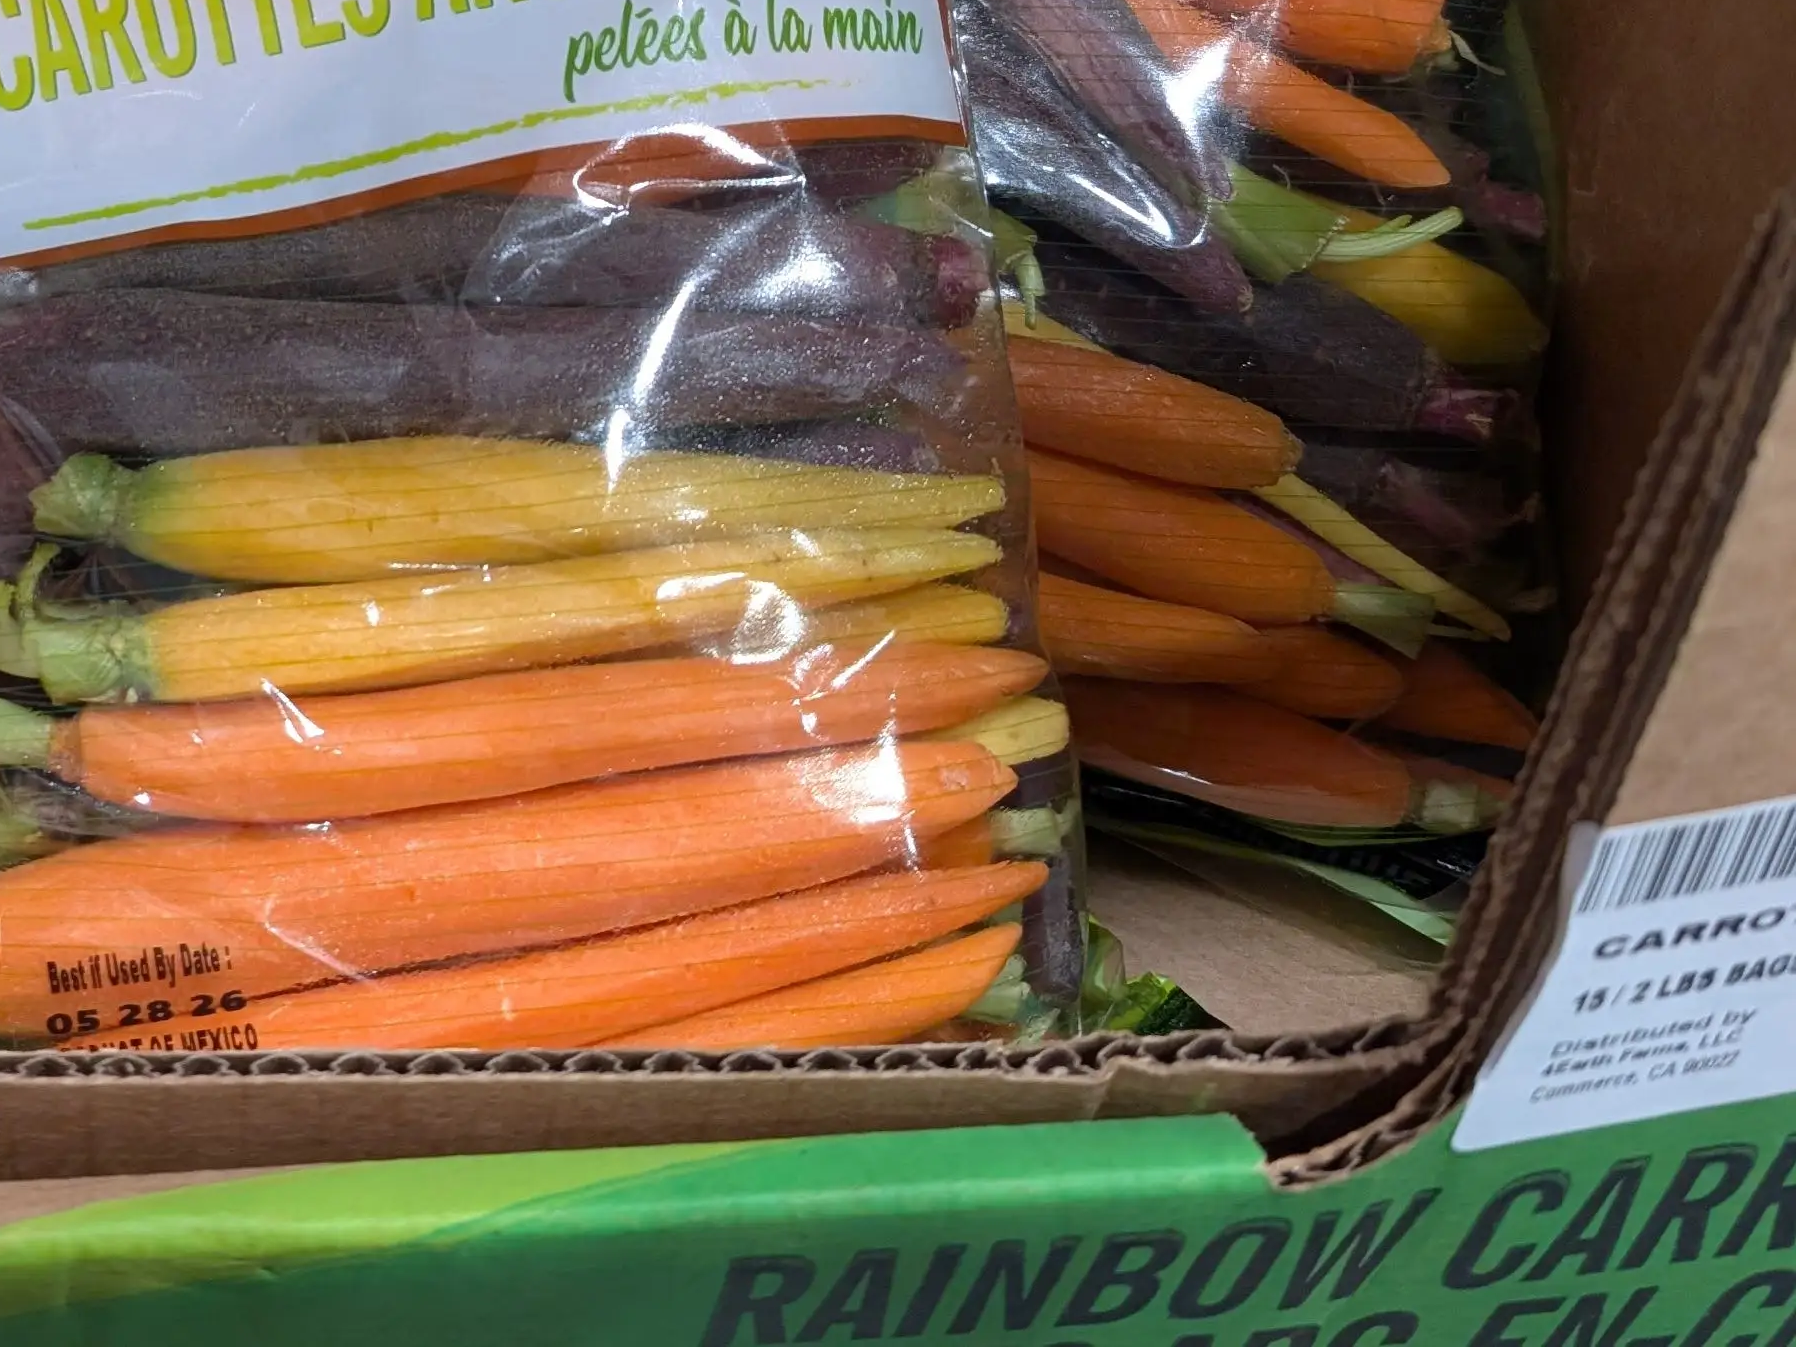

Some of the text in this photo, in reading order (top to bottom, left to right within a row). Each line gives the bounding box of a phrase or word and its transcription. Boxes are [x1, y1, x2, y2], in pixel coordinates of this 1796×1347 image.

[1593, 906, 1796, 961] CARRO
[47, 958, 85, 995] Best
[88, 955, 102, 989] if
[105, 952, 151, 986] Used
[154, 946, 177, 988] By
[179, 942, 221, 977] Date
[1628, 979, 1652, 1005] 2
[1655, 967, 1718, 1000] LBS
[46, 989, 248, 1035] 05 28 26
[1550, 1008, 1758, 1058] Distributed by
[1697, 1027, 1745, 1050] LLC
[1647, 1061, 1676, 1083] CA
[698, 1133, 1796, 1347] RAINBOW CARR
